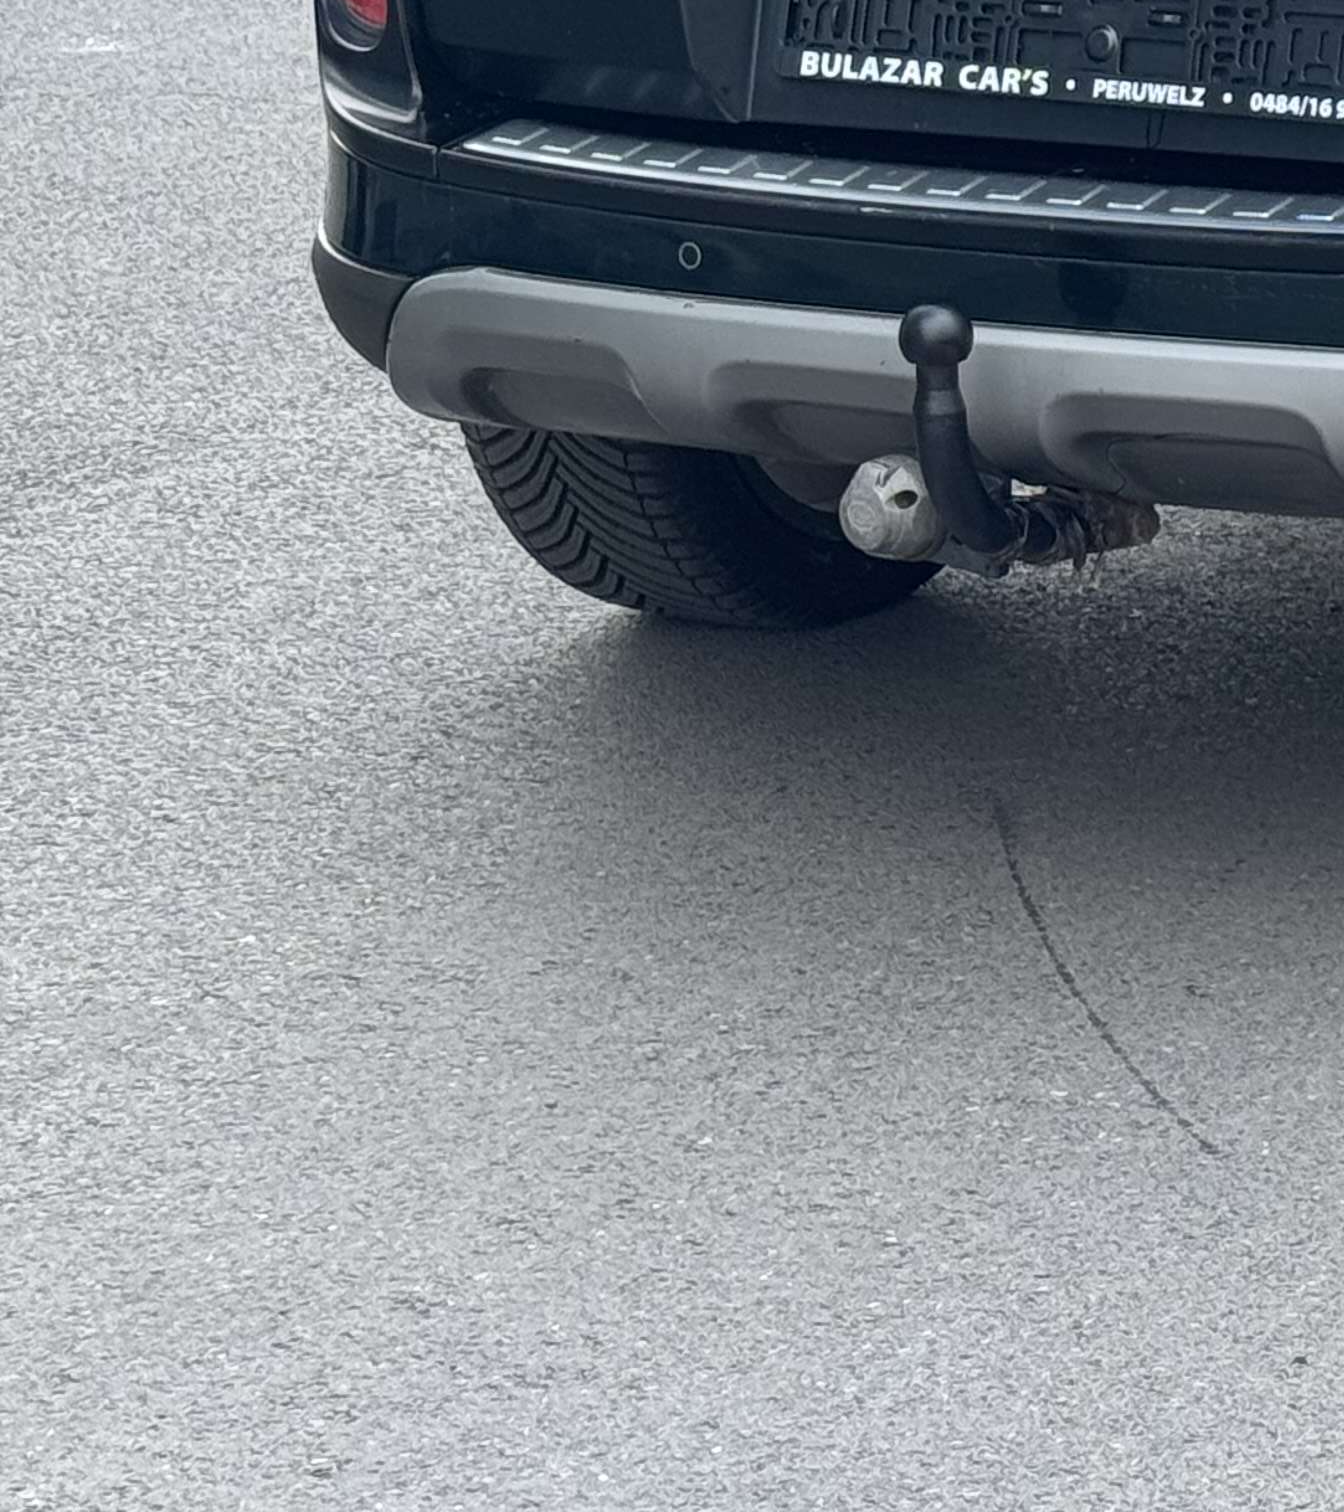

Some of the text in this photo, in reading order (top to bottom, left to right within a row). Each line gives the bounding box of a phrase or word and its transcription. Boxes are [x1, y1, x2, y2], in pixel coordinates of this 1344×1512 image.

[800, 50, 944, 87] BULAZAR
[958, 64, 1050, 97] CAR'S
[1092, 78, 1206, 107] PERUWELZ
[1250, 92, 1333, 118] 0484/16
